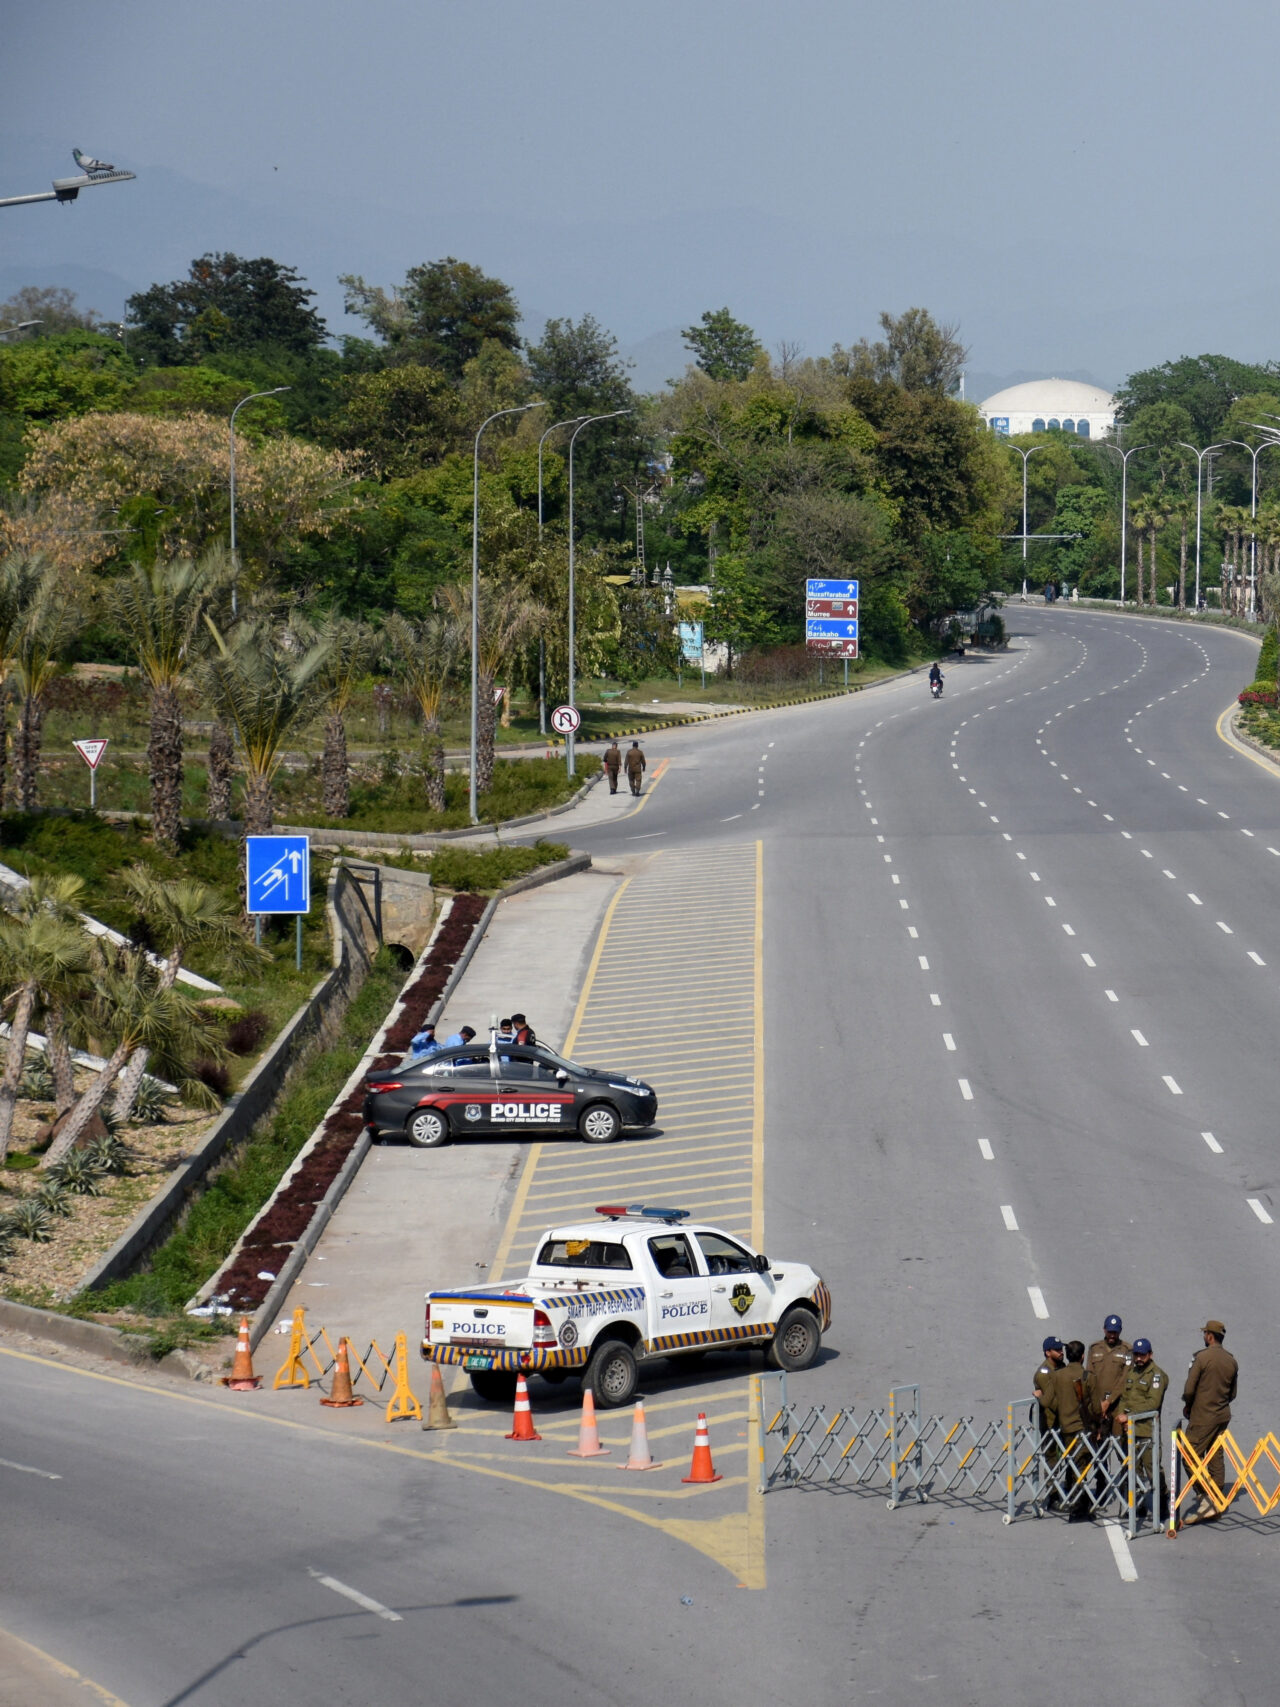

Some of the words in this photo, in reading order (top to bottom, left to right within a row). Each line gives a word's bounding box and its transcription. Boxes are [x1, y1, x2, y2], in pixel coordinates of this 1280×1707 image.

[490, 1103, 562, 1118] POLICE
[568, 1304, 584, 1319] SMART
[586, 1302, 607, 1317] TRAFFIC
[608, 1299, 633, 1314] RESPONSE
[633, 1297, 645, 1311] UNIT
[661, 1303, 708, 1319] POLICE
[452, 1322, 507, 1335] POLICE
